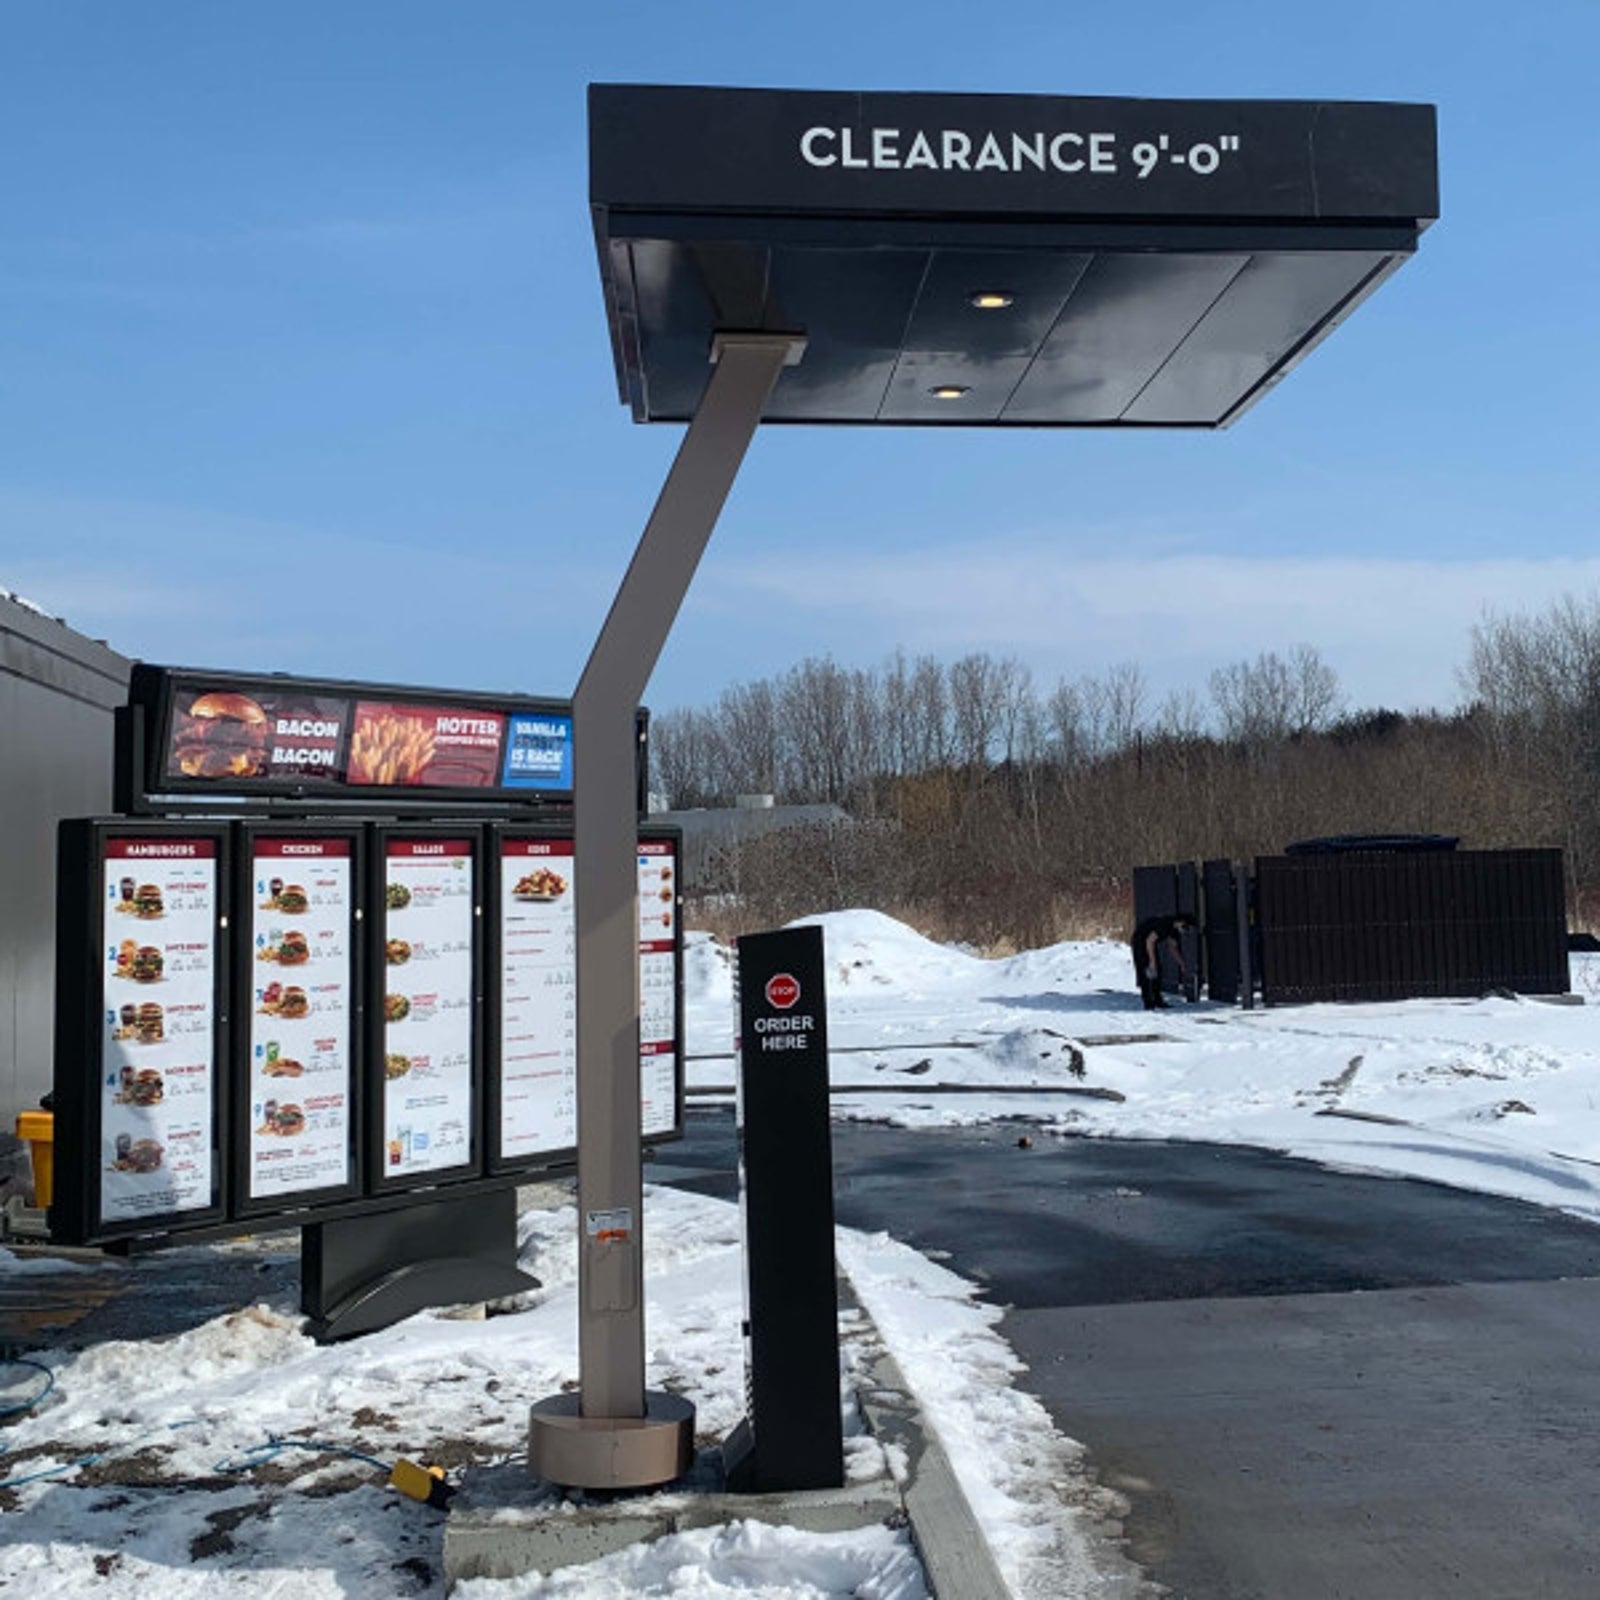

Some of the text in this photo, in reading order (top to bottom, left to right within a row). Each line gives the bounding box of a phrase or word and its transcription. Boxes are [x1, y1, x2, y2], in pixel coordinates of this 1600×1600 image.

[800, 127, 1240, 178] CLEARANCE 9'-0"
[276, 719, 339, 737] BACON
[516, 722, 567, 737] VANILLA
[271, 747, 335, 766] BACON
[126, 844, 196, 856] HAMBURGERS
[771, 986, 796, 996] STOP
[754, 1015, 815, 1033] ORDER
[762, 1034, 808, 1052] HERE
